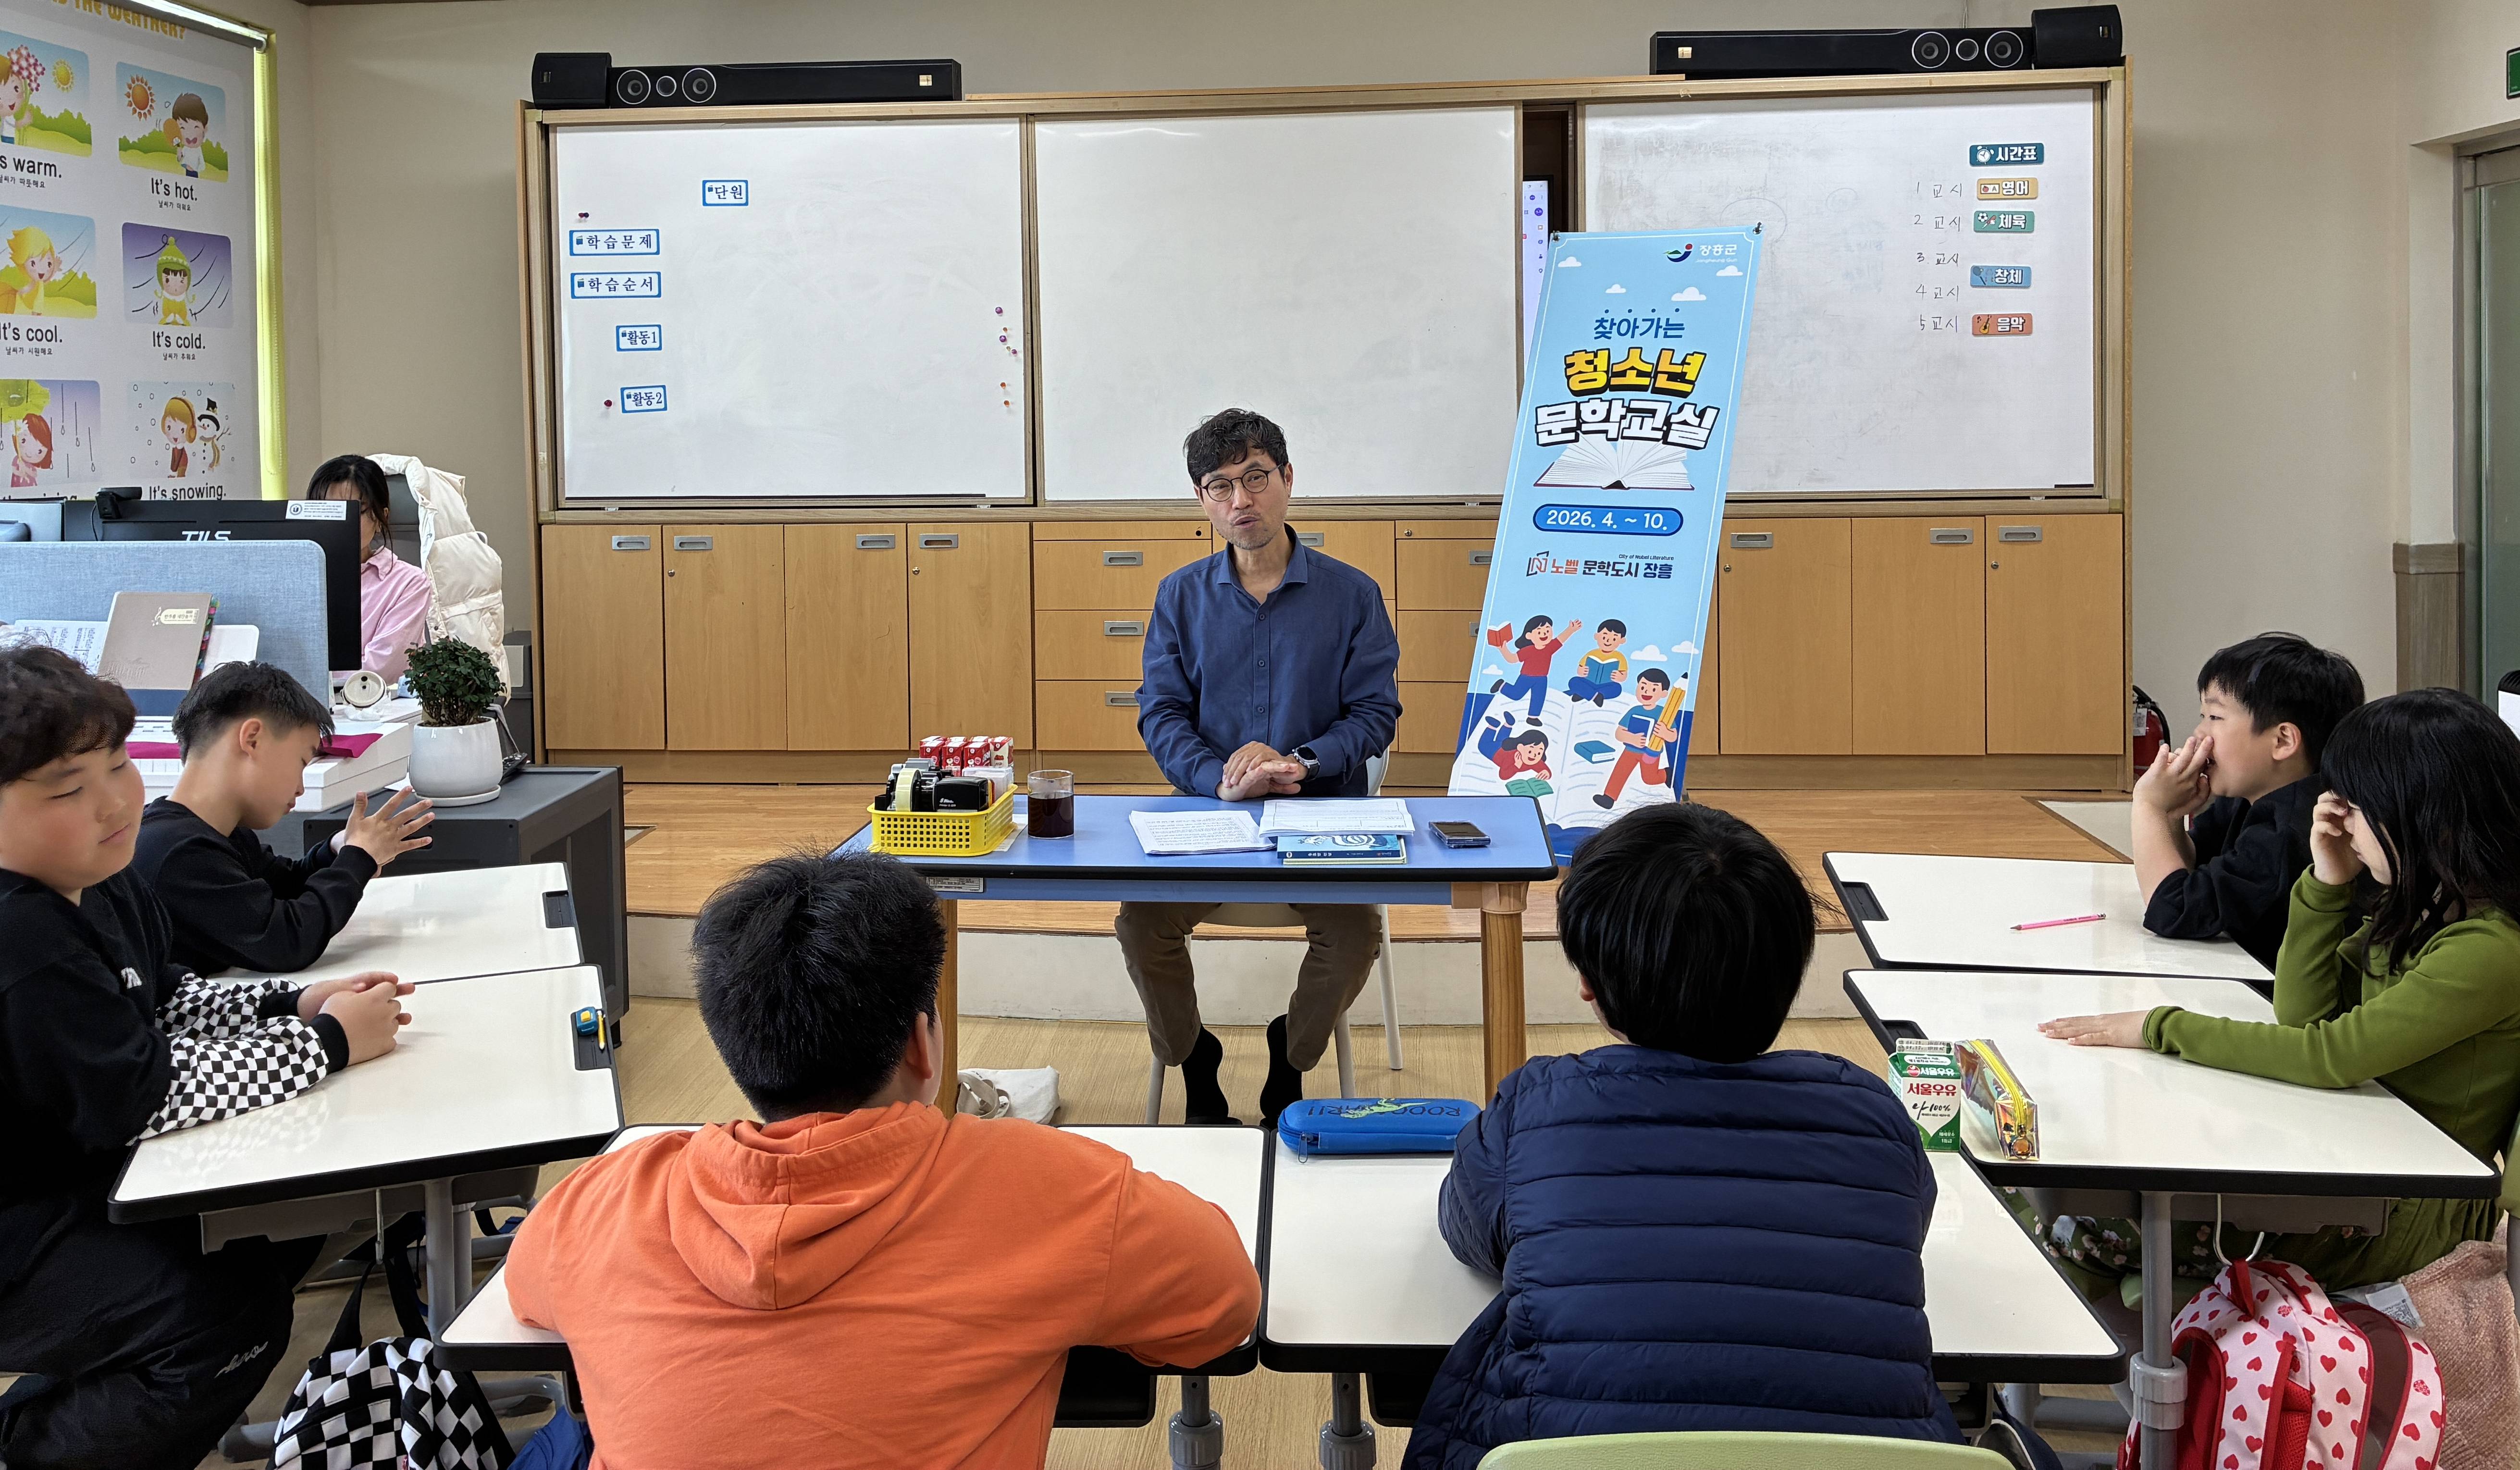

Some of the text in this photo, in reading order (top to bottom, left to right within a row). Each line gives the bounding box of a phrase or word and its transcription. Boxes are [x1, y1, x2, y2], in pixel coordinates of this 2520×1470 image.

[1996, 146, 2037, 162] 시간표
[13, 158, 62, 178] warm.
[151, 177, 197, 201] It's hot.
[715, 185, 743, 199] 단원
[2001, 181, 2029, 196] 영어
[1998, 214, 2026, 229] 체육
[586, 235, 652, 250] 학습문제
[588, 276, 653, 293] 학습순서
[1994, 268, 2023, 284] 창체
[1594, 317, 1685, 340] 찾아가는
[1997, 317, 2026, 332] 음악
[26, 325, 62, 343] cool.
[153, 331, 205, 349] It's cold.
[627, 331, 657, 345] 활동1
[1565, 347, 1706, 398] 청소년
[632, 392, 662, 407] 활동2
[1535, 398, 1720, 450] 문학교실
[172, 482, 226, 500] snowing.
[1546, 509, 1596, 528] 2026.
[1602, 512, 1617, 529] 4.
[1643, 513, 1668, 530] 10.
[1551, 558, 1673, 579] 노벨 문학도시 장흥
[1907, 1083, 1957, 1096] 서울우유
